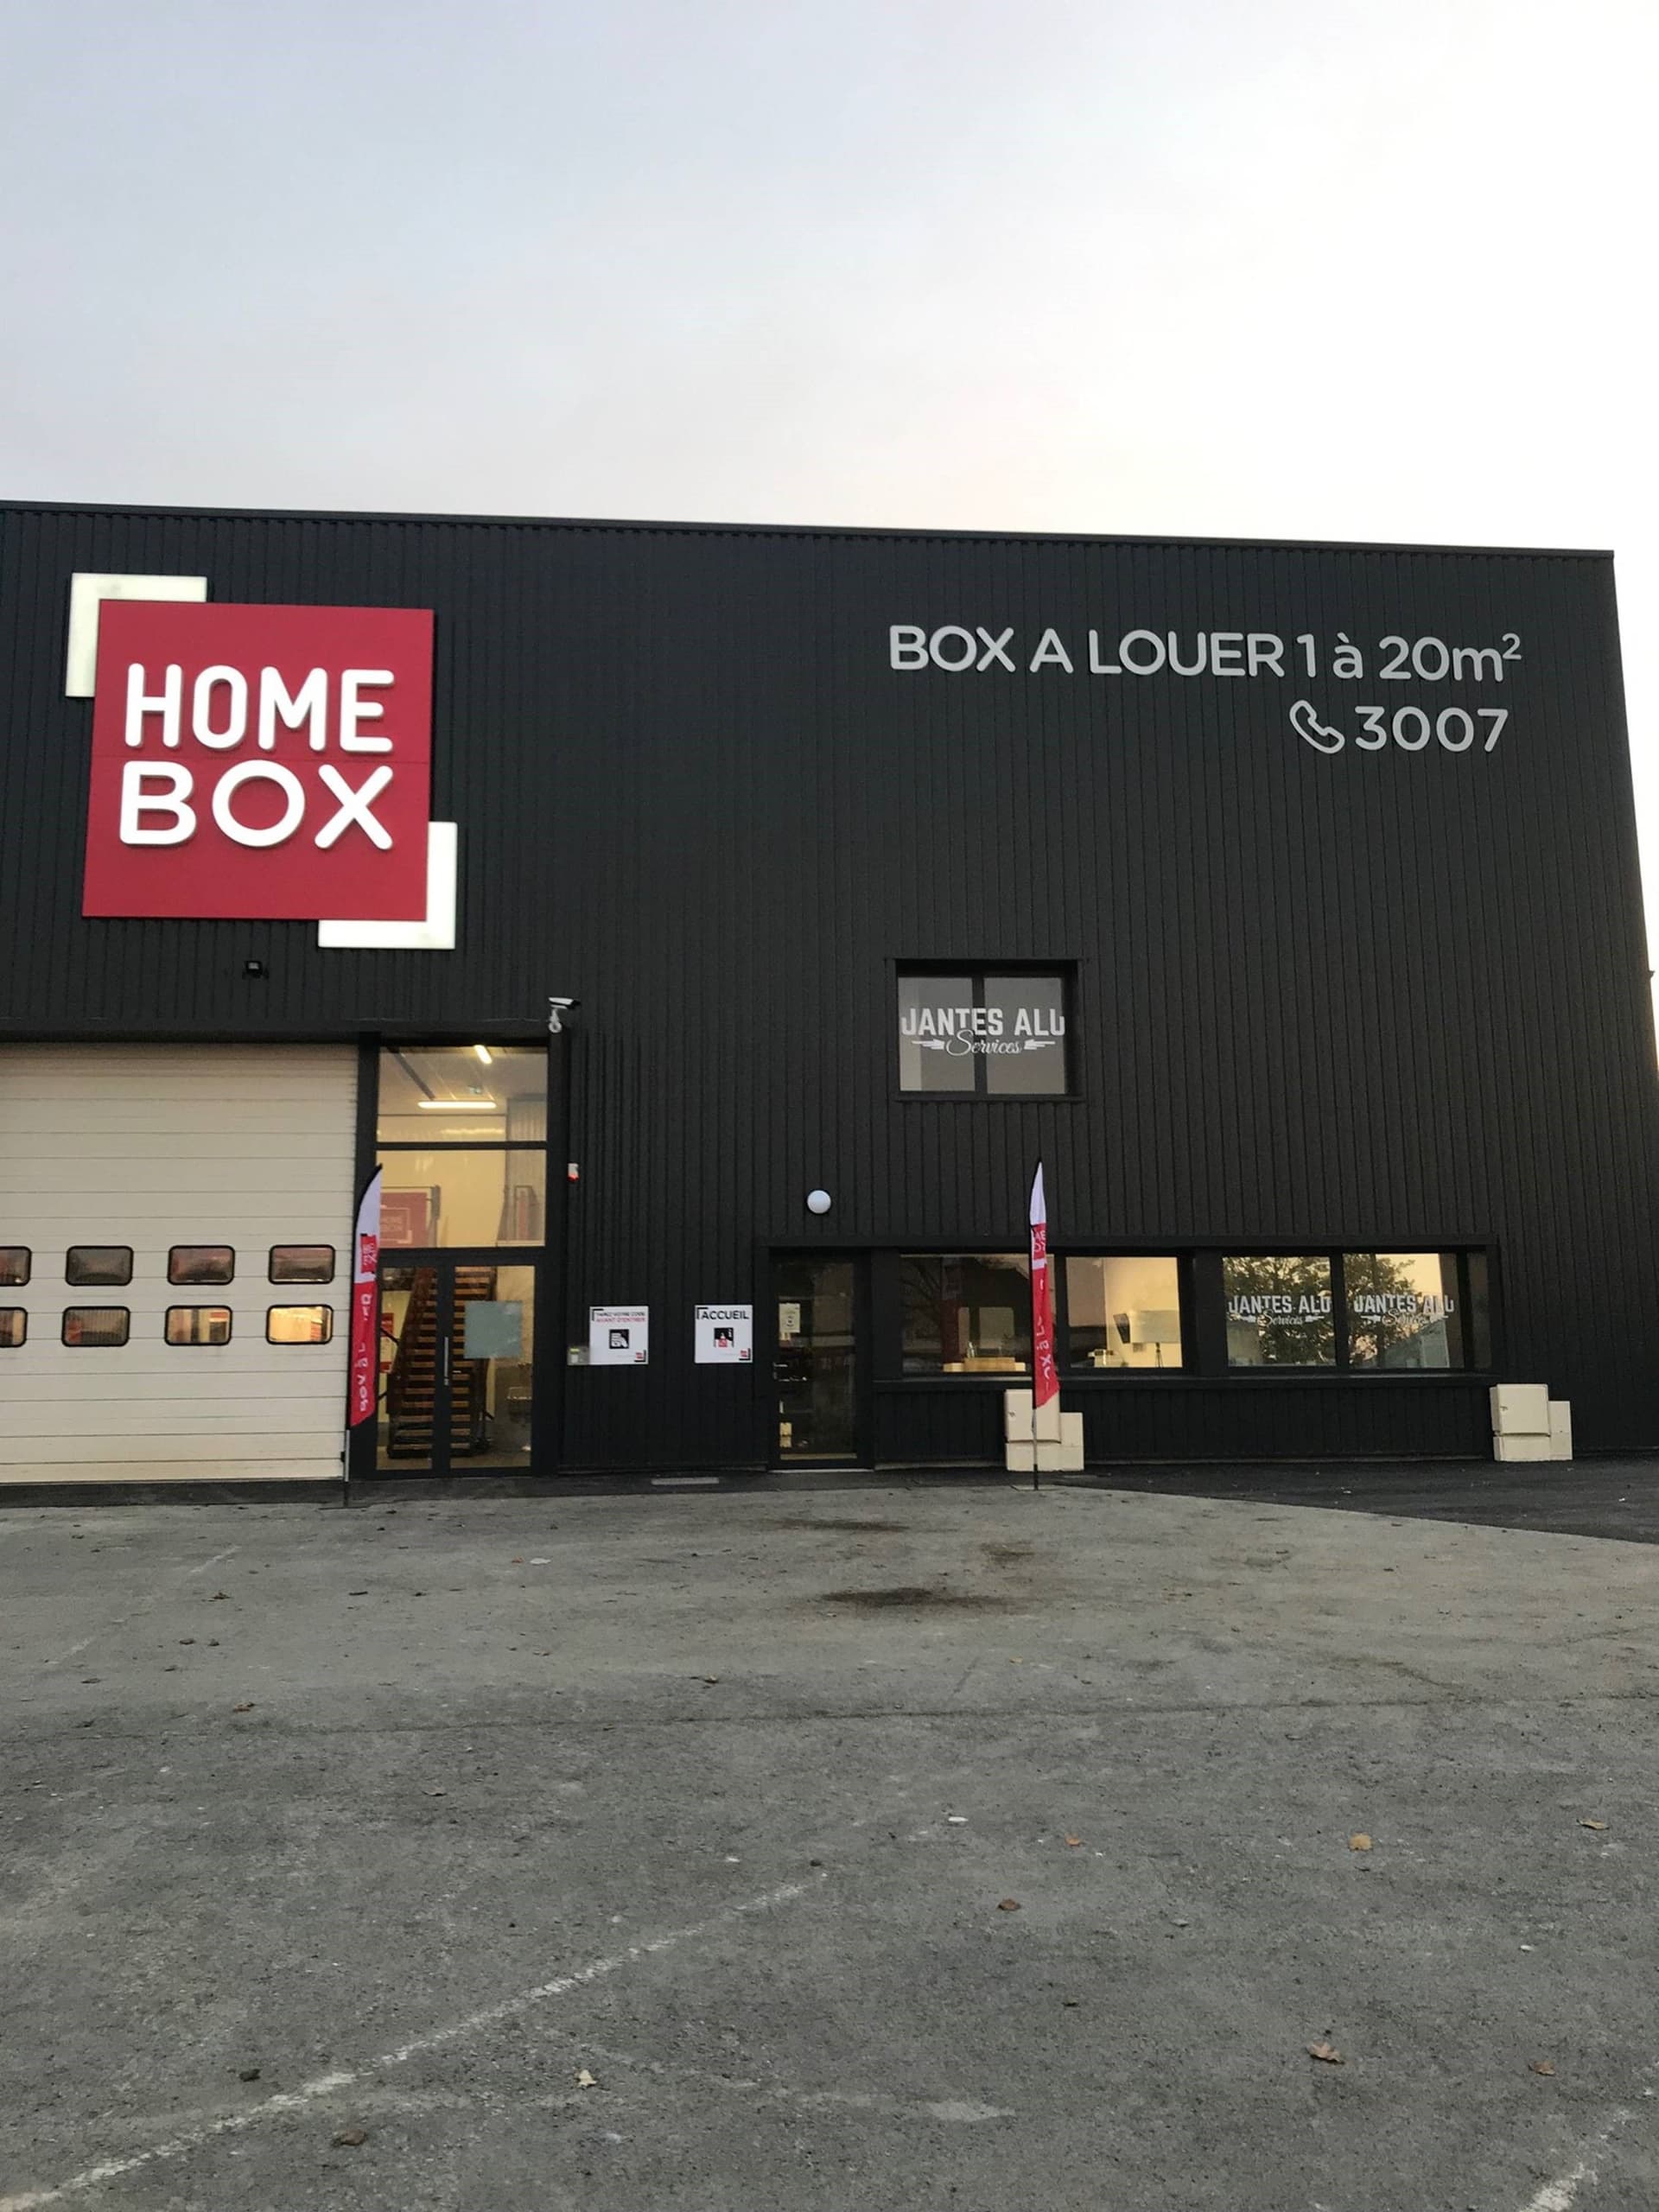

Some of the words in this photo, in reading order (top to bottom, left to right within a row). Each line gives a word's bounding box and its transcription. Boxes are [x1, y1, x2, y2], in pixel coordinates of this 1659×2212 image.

[889, 625, 1016, 672] BOX
[1029, 628, 1075, 674] A
[1089, 629, 1286, 677] LOUER
[1296, 633, 1317, 678] 1
[1332, 632, 1363, 679] à
[124, 663, 395, 753] HOME
[1354, 705, 1510, 753] 3007
[119, 760, 394, 850] BOX
[900, 1007, 1004, 1036] JANTES
[1014, 1007, 1065, 1036] ALU
[946, 1029, 1022, 1056] Services
[702, 1310, 750, 1321] ACCUEIL
[1228, 1295, 1293, 1313] JANTES
[1298, 1295, 1332, 1313] ALU
[1353, 1294, 1417, 1313] JANTES
[1422, 1294, 1455, 1314] ALU
